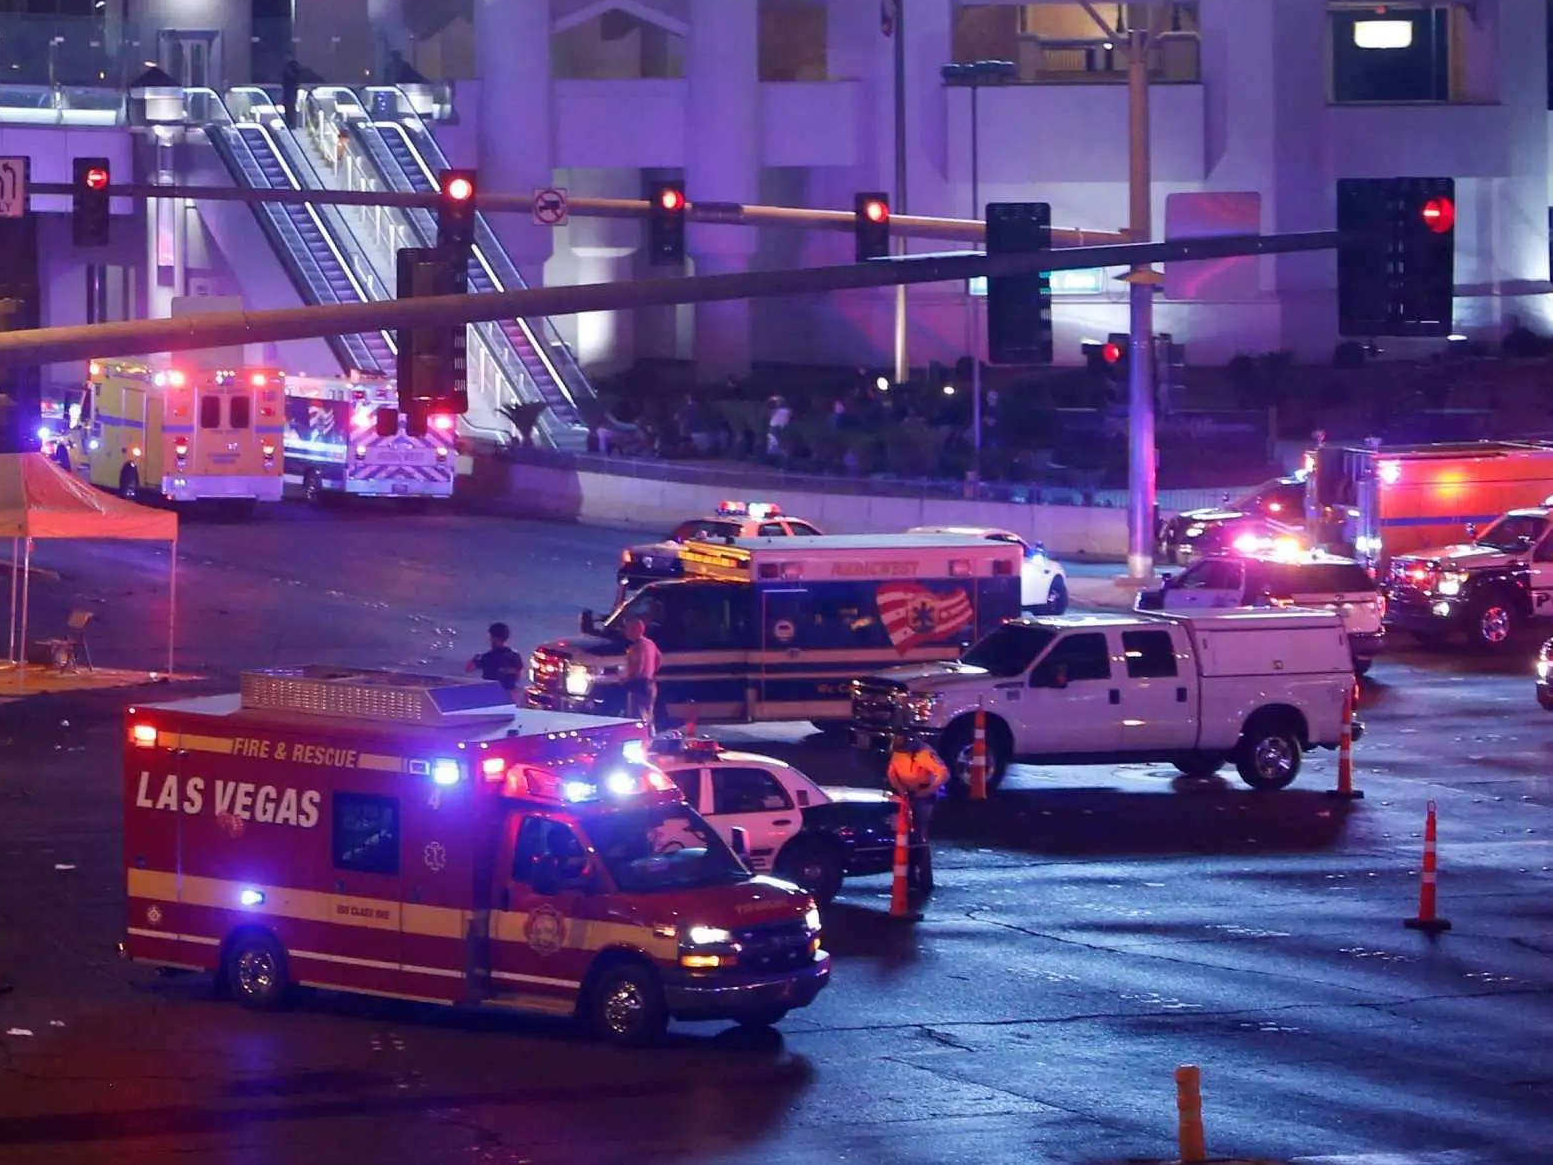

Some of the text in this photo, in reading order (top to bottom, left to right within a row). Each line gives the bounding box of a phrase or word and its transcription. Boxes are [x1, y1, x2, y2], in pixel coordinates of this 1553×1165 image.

[233, 737, 359, 769] FIRE & RESCUE
[136, 771, 322, 828] LAS VEGAS
